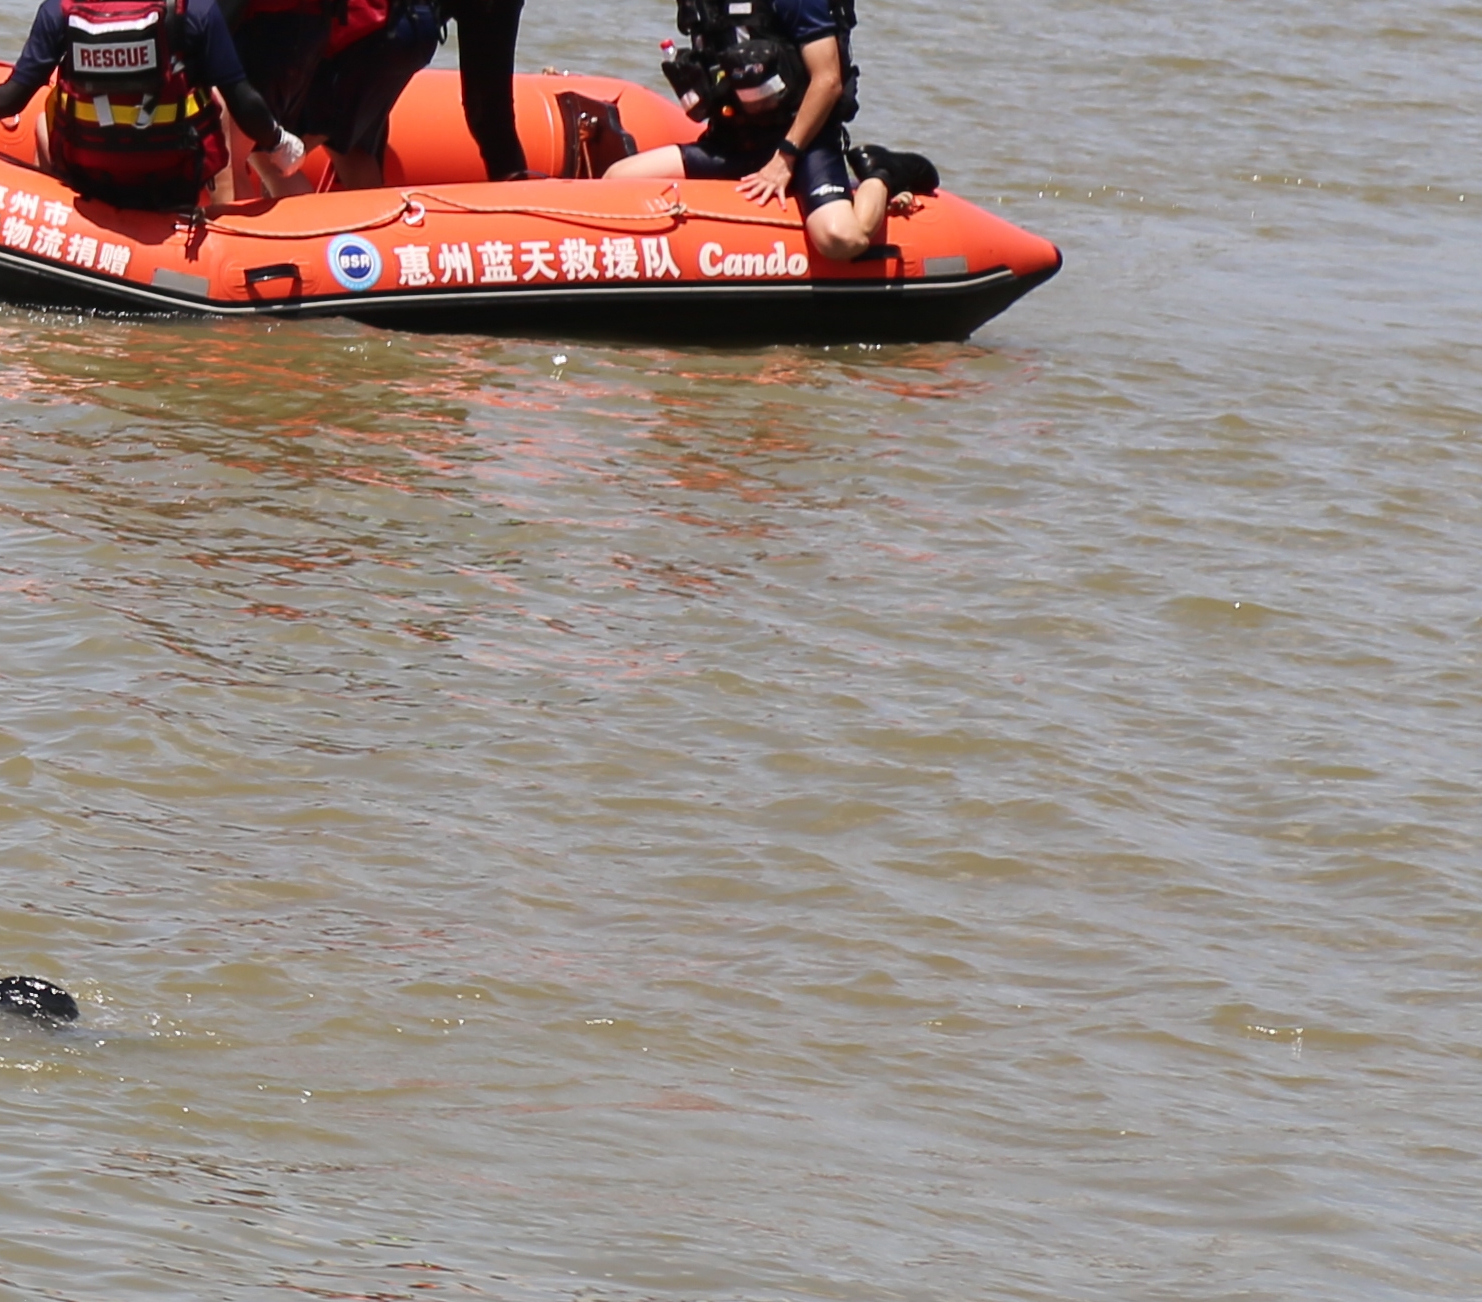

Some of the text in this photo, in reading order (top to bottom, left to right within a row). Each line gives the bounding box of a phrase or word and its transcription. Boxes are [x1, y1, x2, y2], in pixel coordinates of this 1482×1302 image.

[80, 45, 149, 68] RESCUE
[340, 254, 370, 269] BSR
[394, 236, 681, 286] 惠州蓝天救援队
[698, 241, 809, 278] Cando
